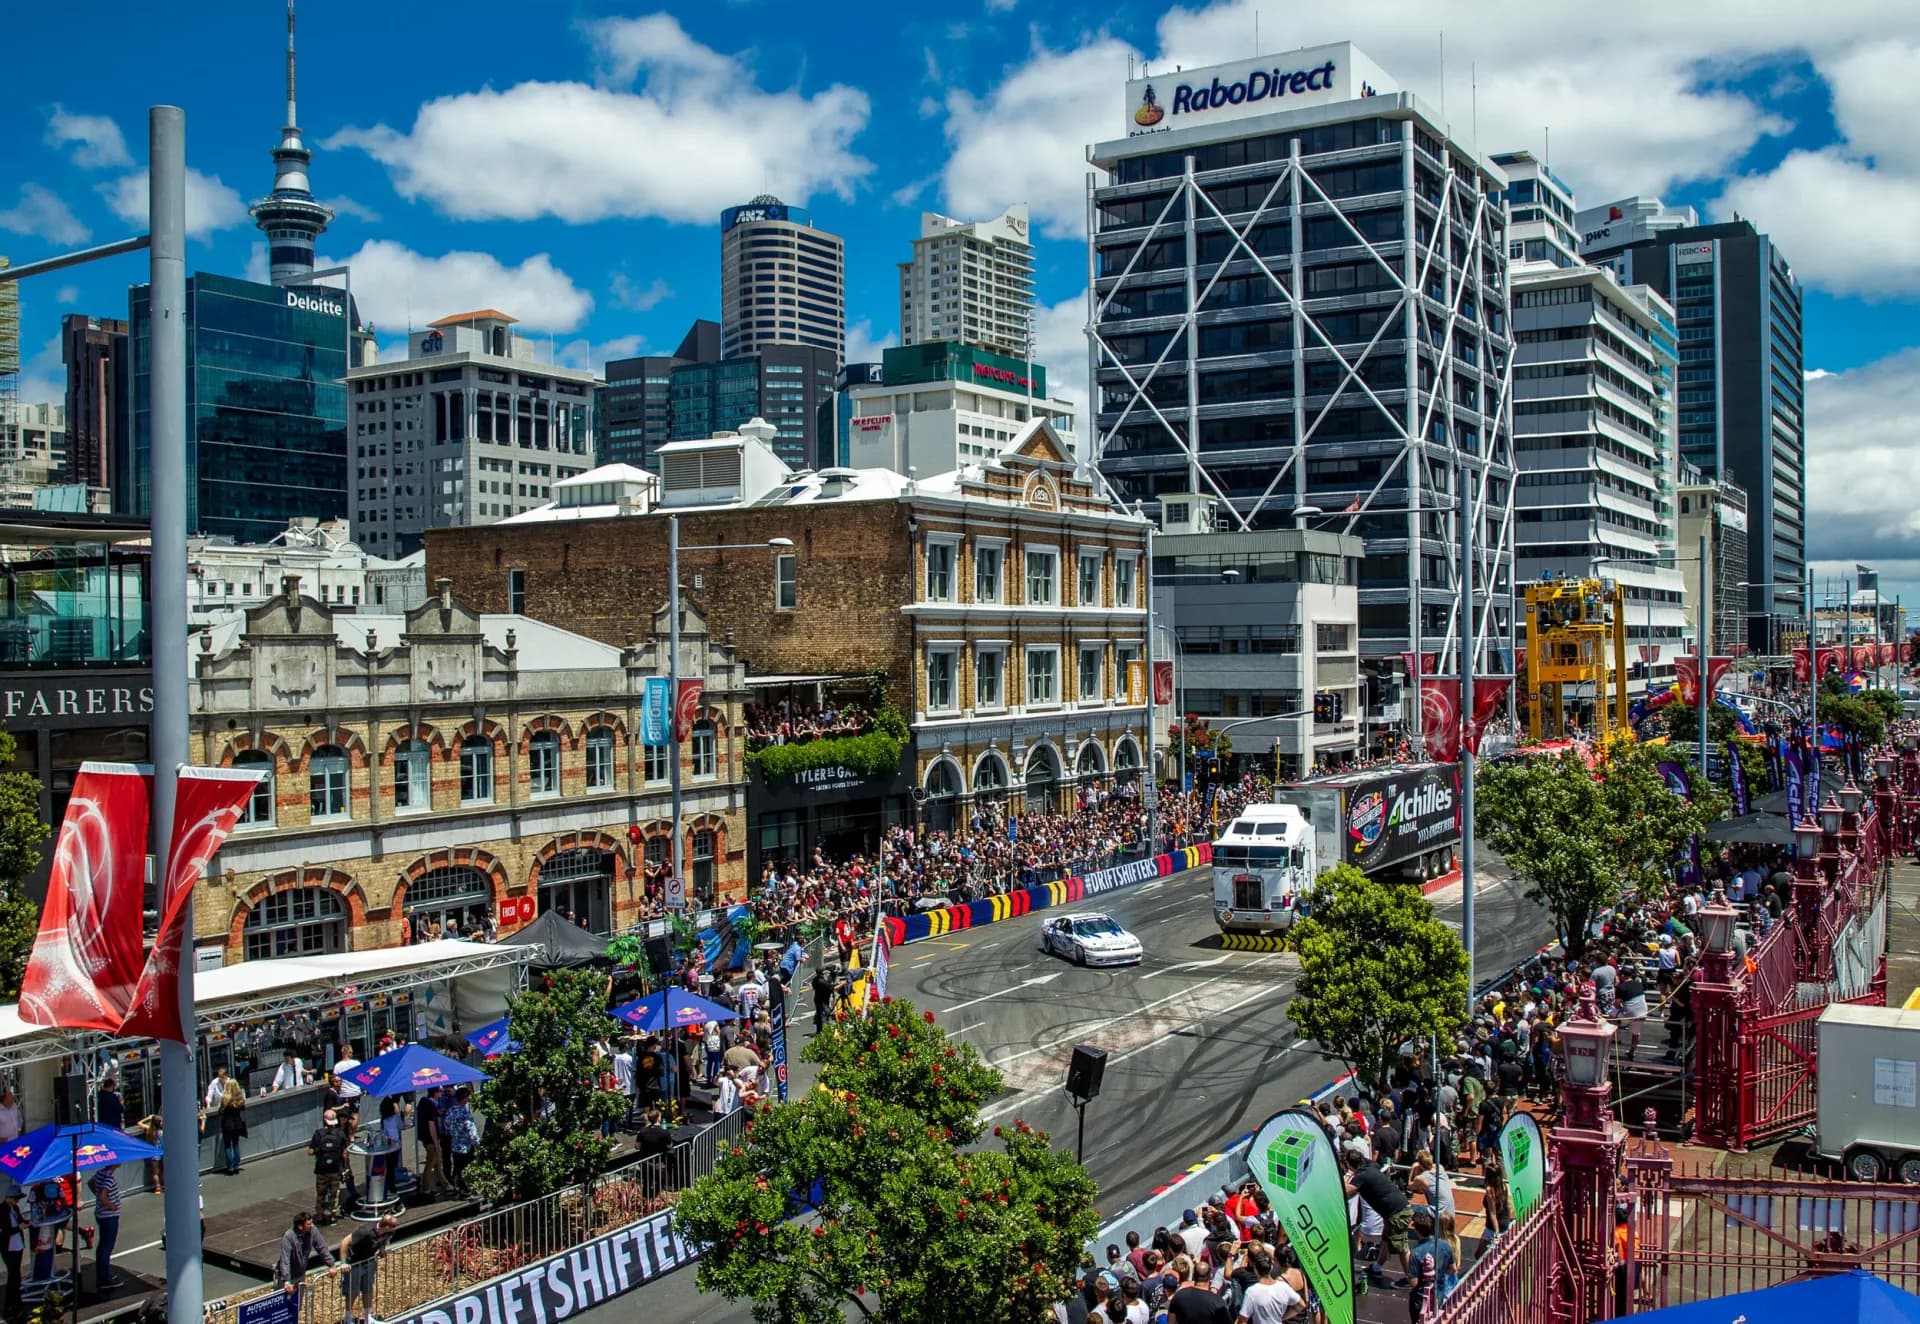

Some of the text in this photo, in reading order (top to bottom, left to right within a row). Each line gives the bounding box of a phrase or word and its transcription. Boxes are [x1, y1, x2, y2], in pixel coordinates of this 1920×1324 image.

[1172, 61, 1335, 115] RaboDirect
[736, 209, 765, 223] ANZ
[1585, 228, 1610, 246] pwc
[1679, 247, 1699, 256] HSBC
[287, 291, 343, 316] Deloitte
[4, 687, 154, 717] FARERS
[649, 685, 663, 741] BRITOMART
[1388, 783, 1452, 826] Achilles
[1399, 820, 1418, 836] RADIAL
[1085, 858, 1158, 893] #DRIFTSHIFTERS
[1576, 1047, 1590, 1056] IN
[76, 1151, 118, 1166] ed Bull
[247, 1296, 284, 1311] AUTOMATION
